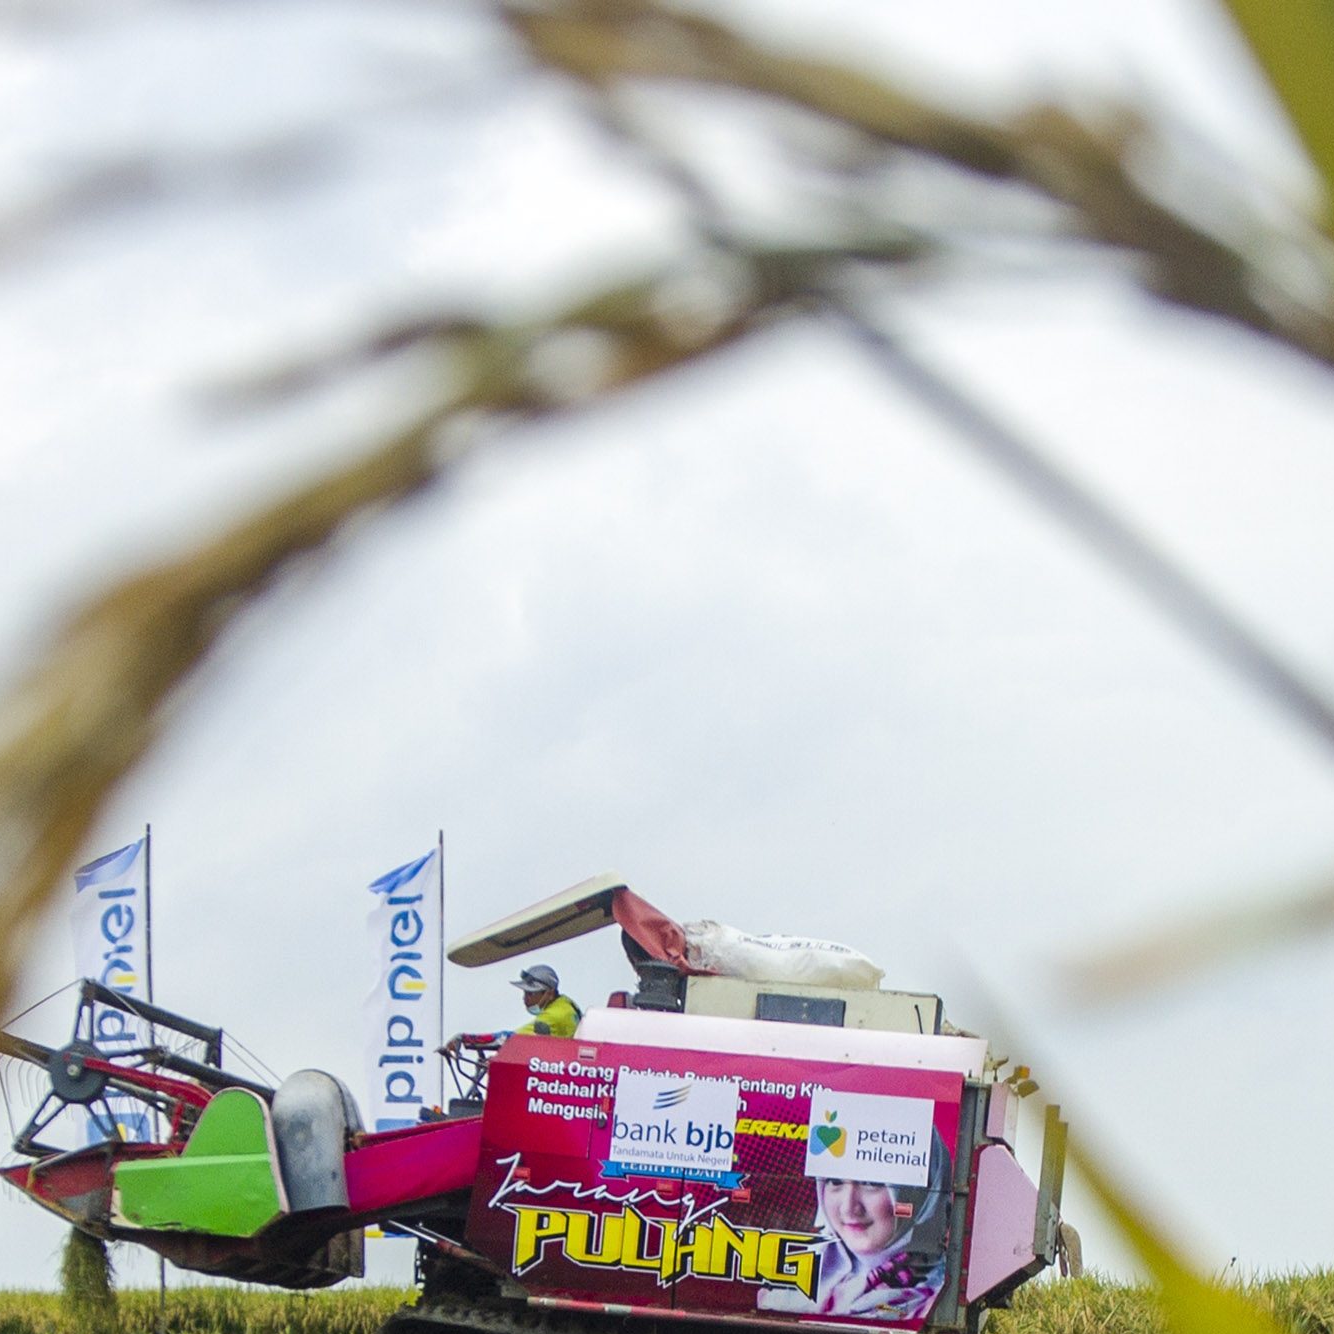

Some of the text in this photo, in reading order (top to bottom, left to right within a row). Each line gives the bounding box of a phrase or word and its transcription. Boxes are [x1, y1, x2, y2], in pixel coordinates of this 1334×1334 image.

[526, 1076, 595, 1099] Padahal
[528, 1056, 565, 1075] Saat
[732, 1075, 797, 1099] Tentang
[612, 1114, 734, 1153] bank bjb
[735, 1118, 809, 1140] EREKA
[857, 1129, 916, 1147] petani
[612, 1144, 665, 1160] Tandamata
[667, 1151, 696, 1164] Untuk
[697, 1154, 730, 1167] Negeri
[855, 1147, 927, 1168] milenial
[512, 1202, 820, 1303] PULANG
